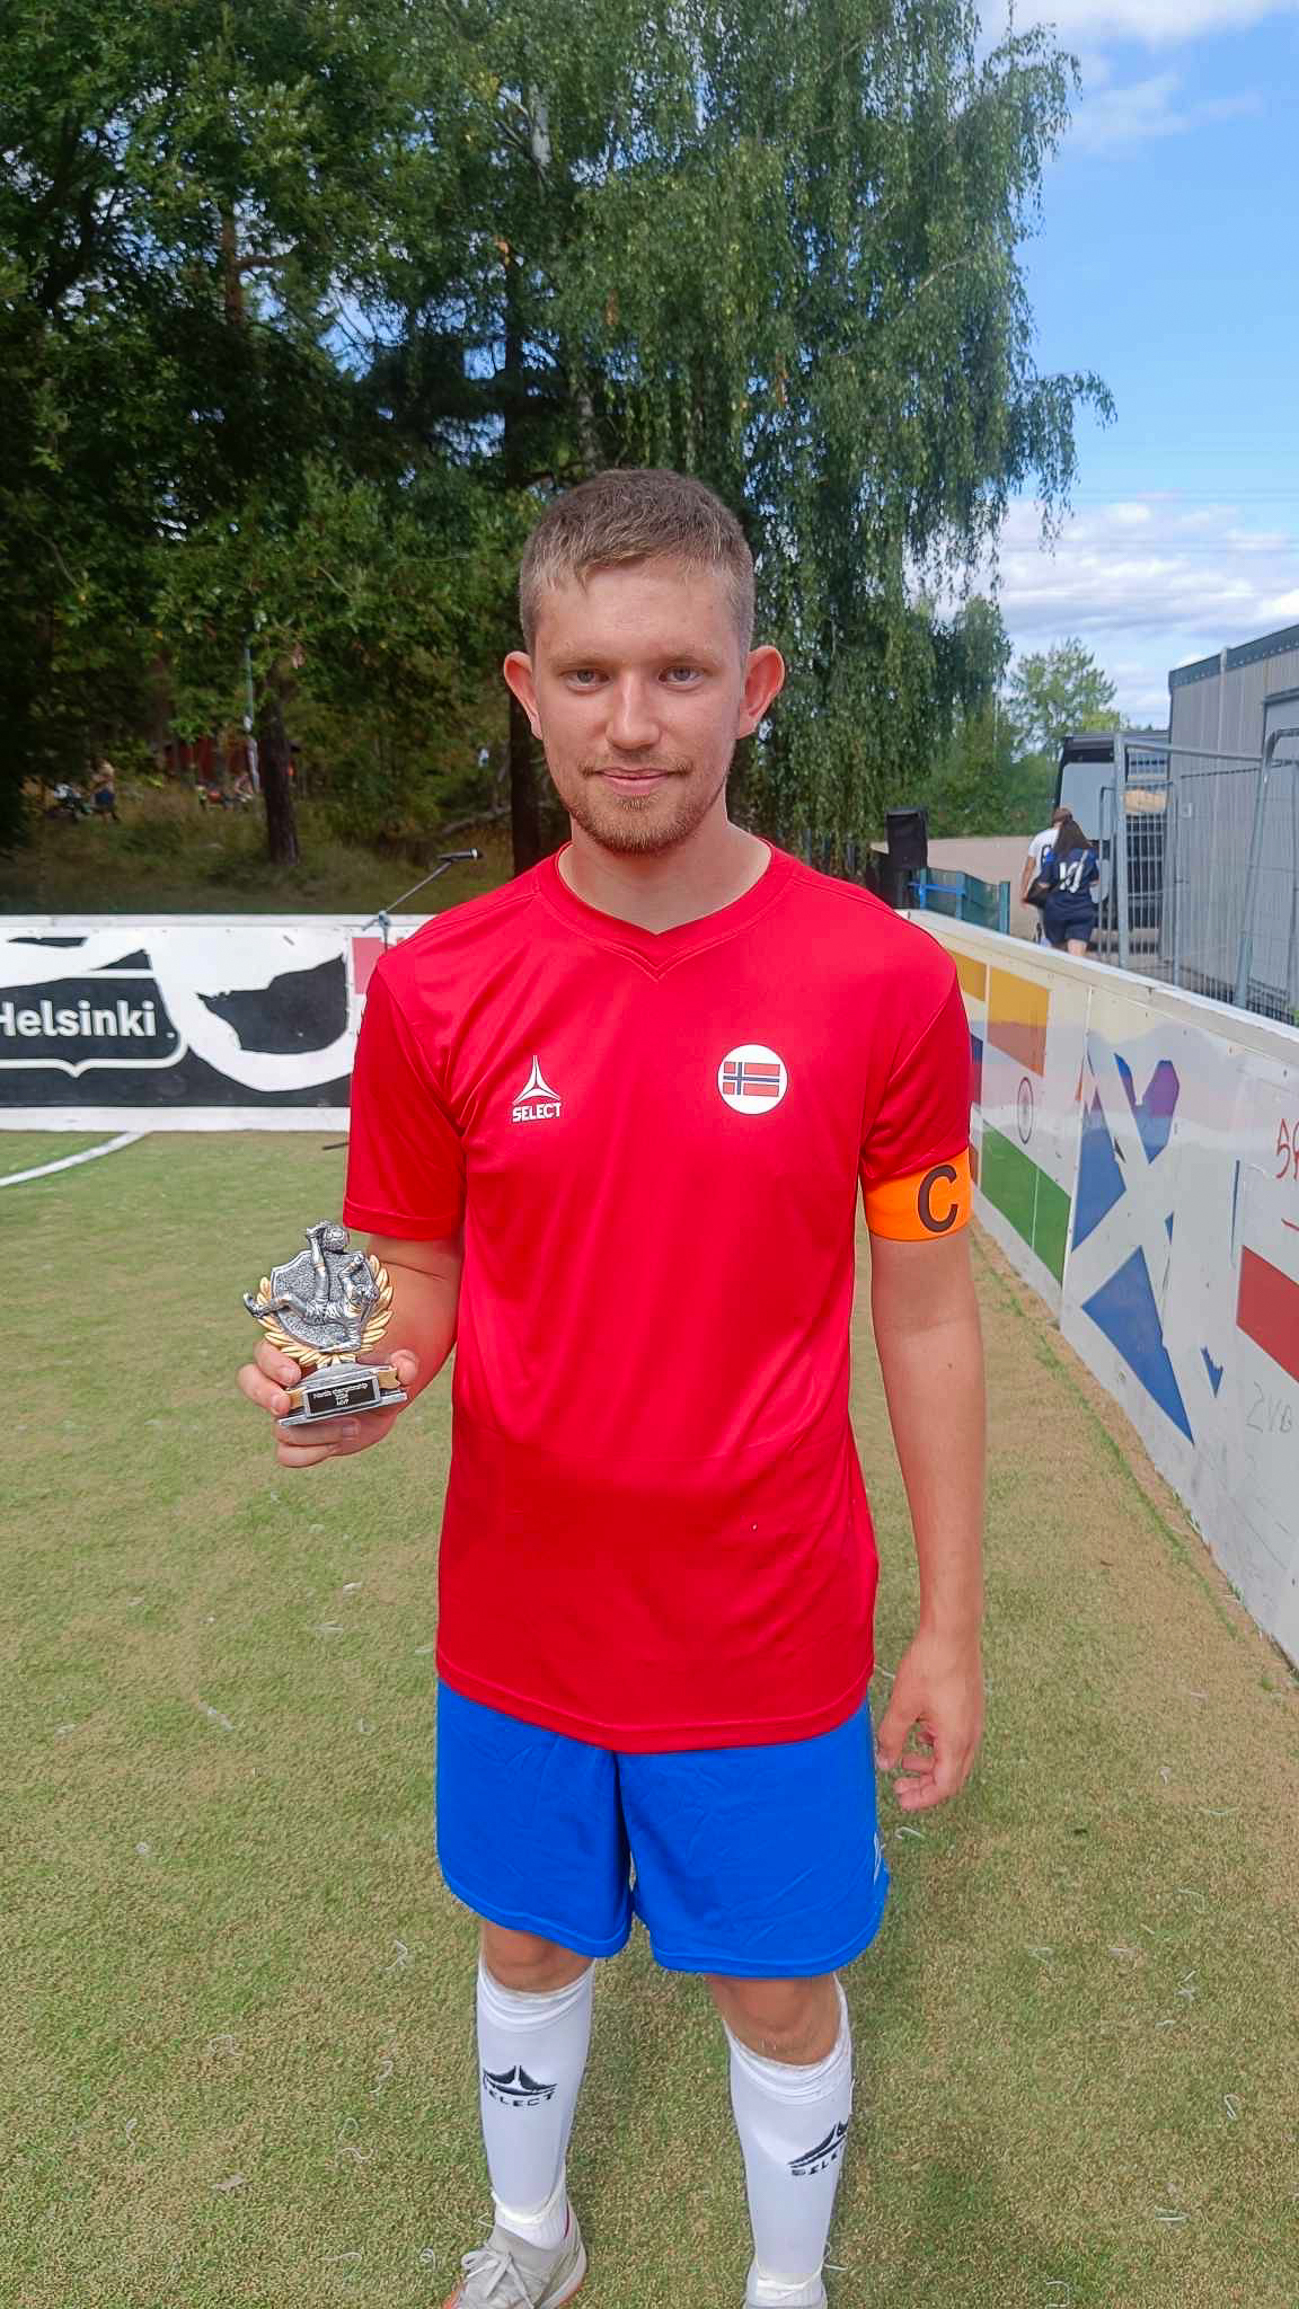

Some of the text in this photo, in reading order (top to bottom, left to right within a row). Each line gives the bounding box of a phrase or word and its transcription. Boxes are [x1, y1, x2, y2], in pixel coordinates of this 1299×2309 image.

[0, 1000, 156, 1036] Helsinki
[512, 1102, 561, 1123] SELECT
[917, 1164, 958, 1233] C
